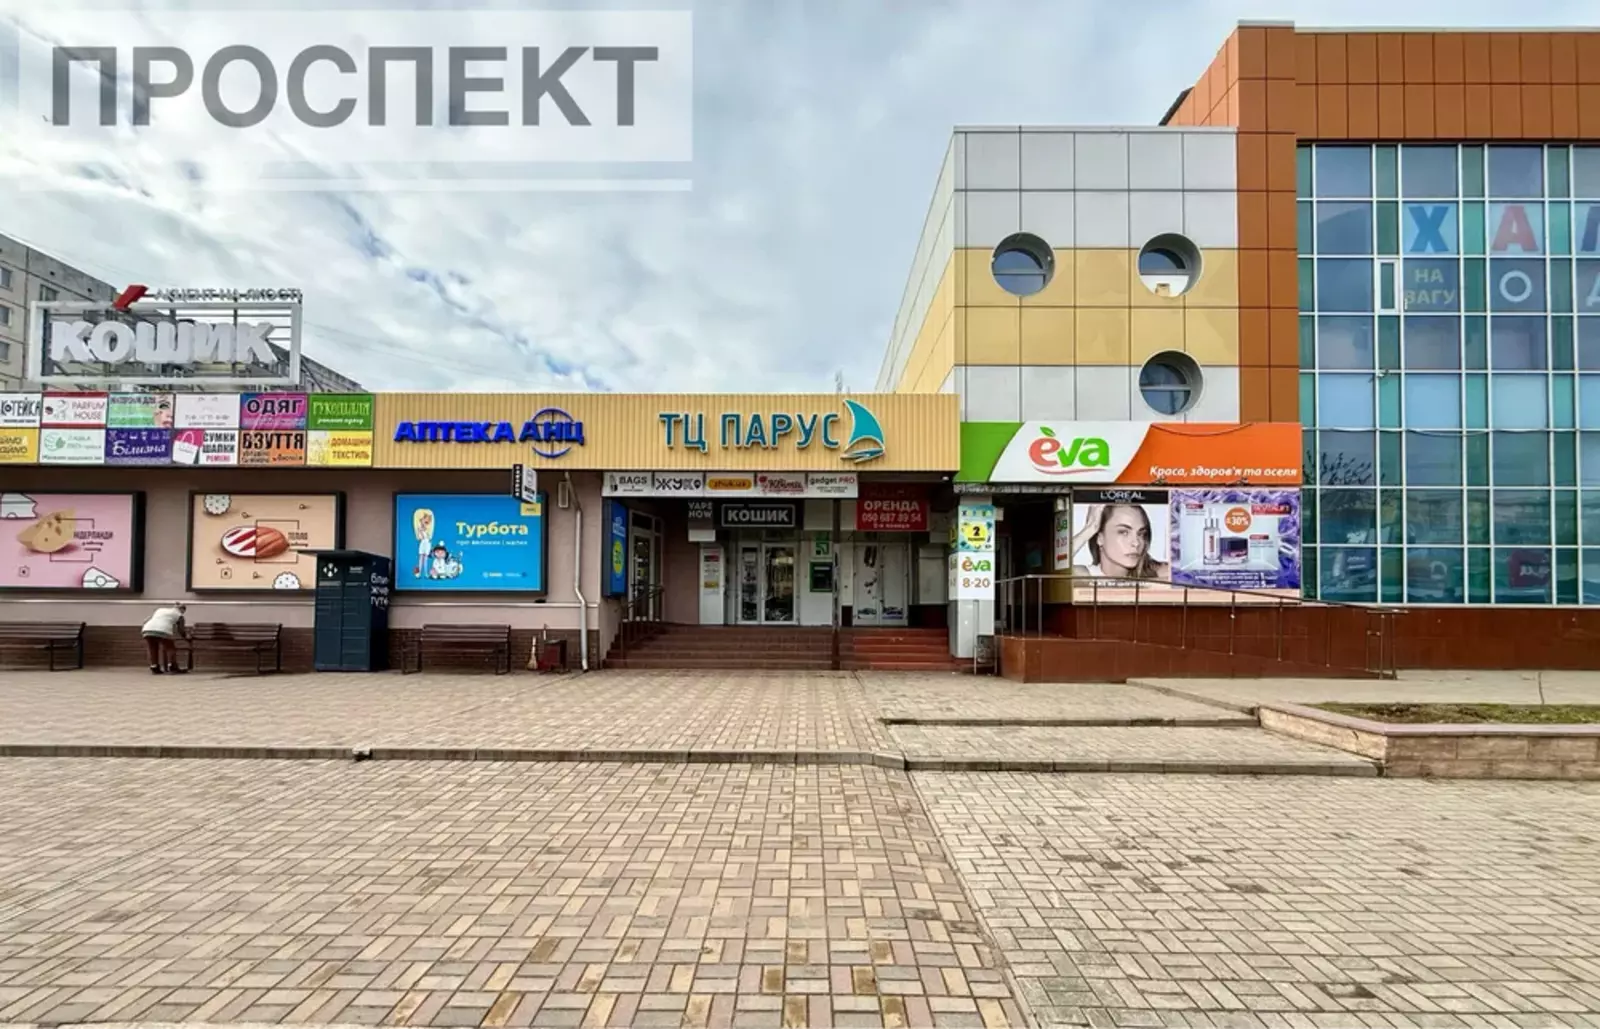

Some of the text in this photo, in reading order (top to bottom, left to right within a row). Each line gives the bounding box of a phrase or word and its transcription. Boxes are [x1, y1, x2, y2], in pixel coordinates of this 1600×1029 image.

[1415, 269, 1444, 283] НА
[1405, 290, 1456, 304] ВАГУ
[50, 321, 279, 364] КОШИК
[247, 399, 302, 415] ОДЯГ
[203, 433, 236, 442] СУМКИ
[394, 421, 584, 446] АПТЕКА АНЦ
[659, 413, 840, 453] ТЦ ПАРУС
[113, 440, 166, 456] Білизна
[242, 433, 304, 449] ВЗУТТЯ
[203, 444, 235, 453] ШАПКИ
[332, 450, 370, 460] ТЕКСТИЛЬ
[1150, 465, 1298, 479] Краса, здоров'я та оселя
[619, 476, 647, 484] BAGS
[810, 475, 837, 485] gadget
[839, 476, 855, 484] PRO
[864, 500, 920, 512] ОРЕНДА
[727, 510, 789, 522] КОШИК
[456, 521, 529, 538] Турбота
[972, 526, 980, 536] 2
